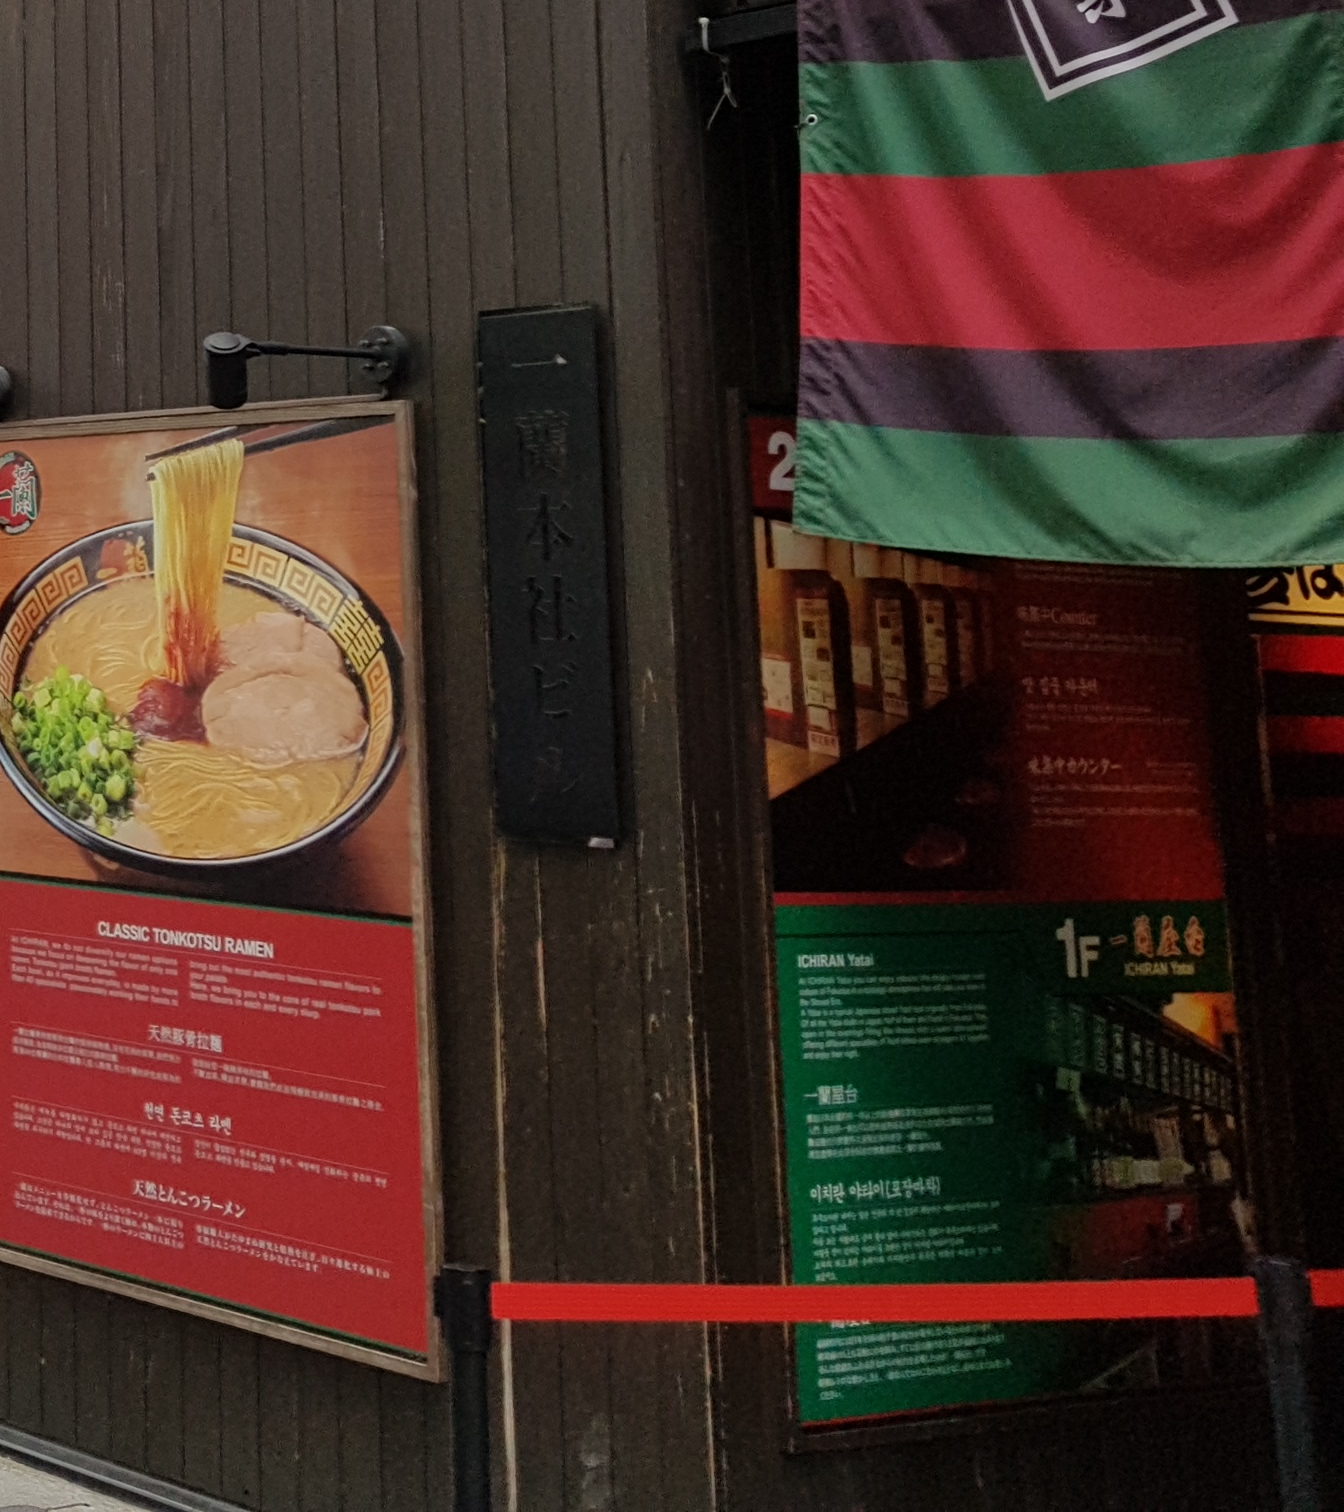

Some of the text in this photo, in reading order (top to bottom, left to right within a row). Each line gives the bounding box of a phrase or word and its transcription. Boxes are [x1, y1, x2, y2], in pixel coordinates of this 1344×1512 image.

[97, 920, 274, 958] CLASSIC TONKOTSU RAMEN
[1055, 918, 1100, 978] 1F
[798, 953, 874, 968] ICHIRAN Yatai
[132, 1179, 246, 1218] 天然とんこつラーメン
